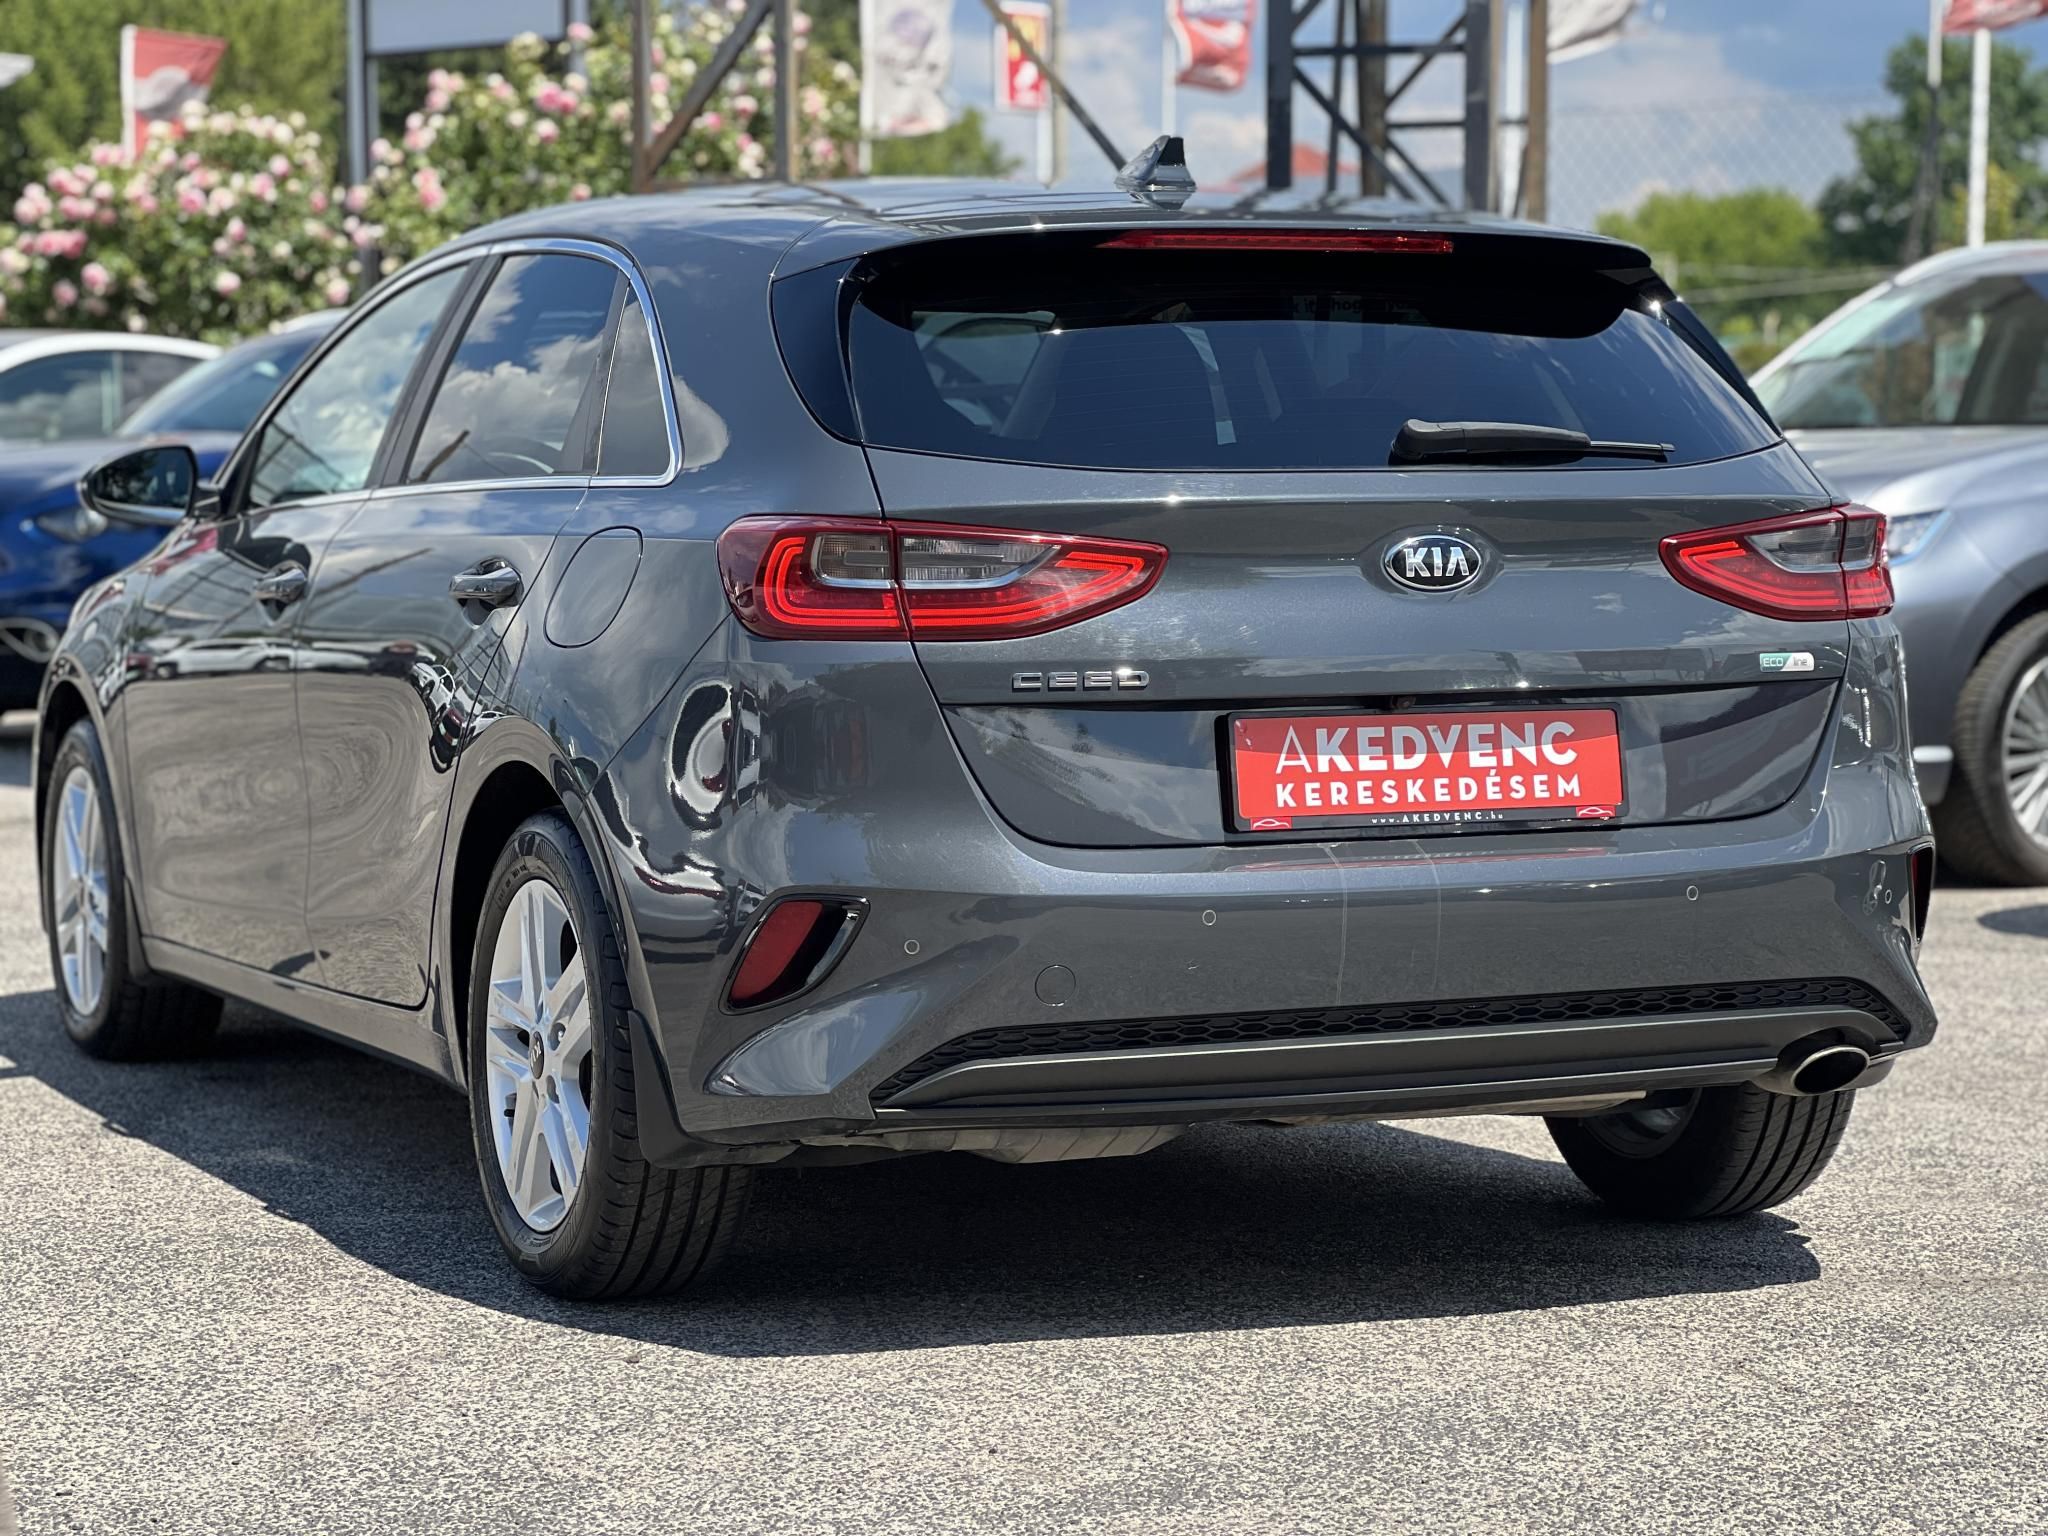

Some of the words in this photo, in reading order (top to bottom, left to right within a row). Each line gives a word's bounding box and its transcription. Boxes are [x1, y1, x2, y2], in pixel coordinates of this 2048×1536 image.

[1404, 546, 1470, 577] KIA
[1763, 657, 1784, 667] ECO
[1012, 670, 1150, 690] CEED
[1276, 769, 1582, 808] KERESKEDÉSEM
[1371, 810, 1504, 824] www.AKEDVENC.hu
